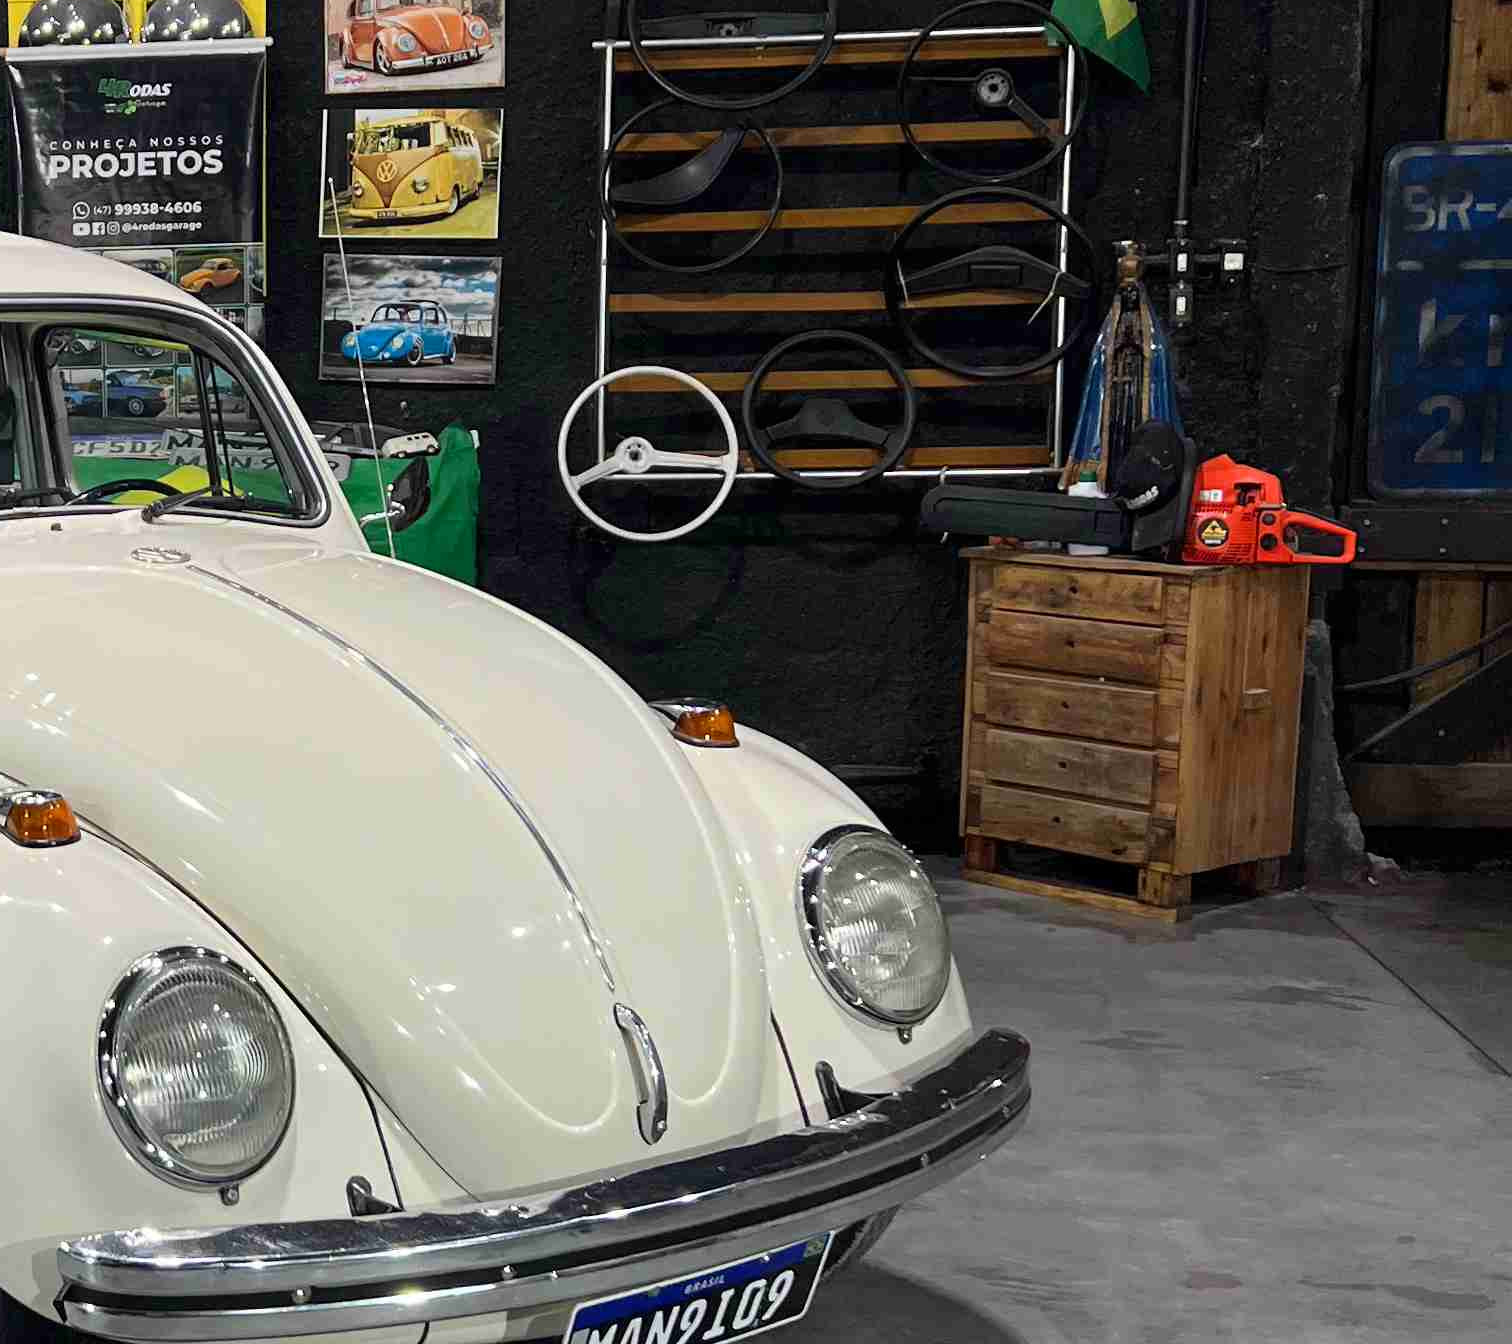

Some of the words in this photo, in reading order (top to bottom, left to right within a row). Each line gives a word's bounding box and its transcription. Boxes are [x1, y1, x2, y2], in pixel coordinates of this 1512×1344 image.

[49, 138, 137, 151] CONHEÇA
[149, 135, 224, 147] NOSSOS
[49, 148, 224, 179] PROJETOS
[114, 201, 203, 216] 99938-4606
[683, 1275, 726, 1295] BRASIL
